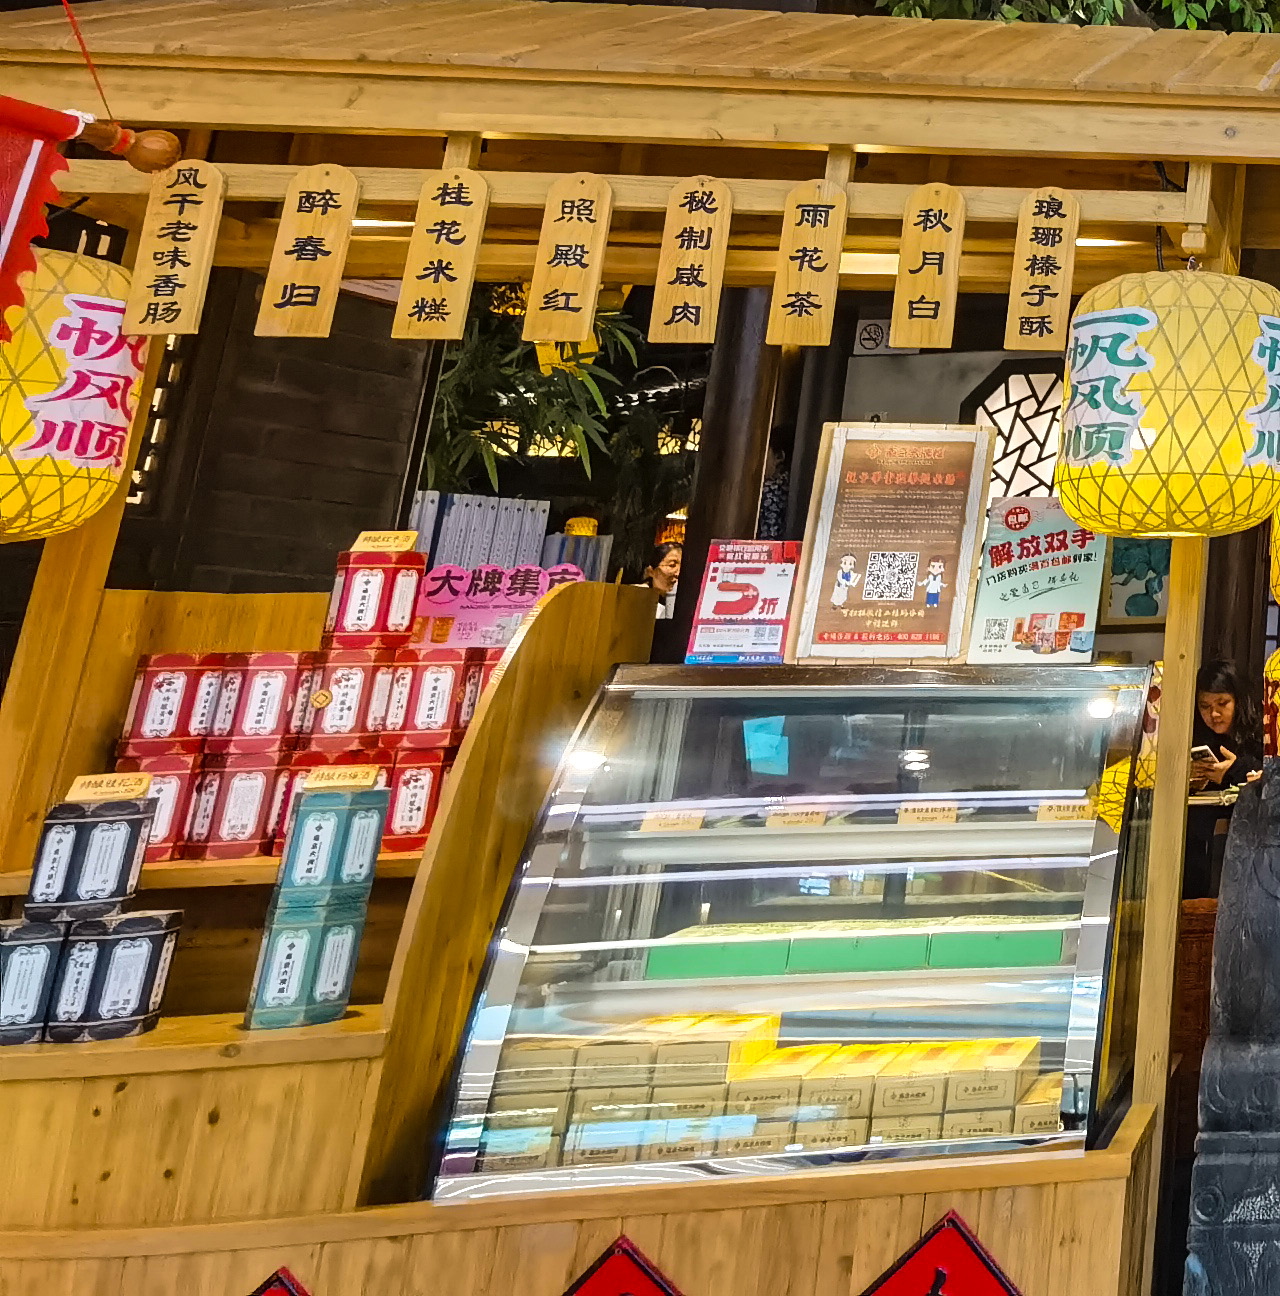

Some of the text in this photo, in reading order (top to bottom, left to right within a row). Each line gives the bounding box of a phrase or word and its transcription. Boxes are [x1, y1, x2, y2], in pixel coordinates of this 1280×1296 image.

[139, 167, 204, 326] 风干老味香肠
[273, 189, 342, 309] 醉春归
[409, 182, 473, 323] 桂花米糕
[539, 197, 597, 313] 照殿红
[664, 189, 718, 327] 秘制咸肉
[781, 202, 836, 318] 雨花茶
[907, 207, 952, 320] 秋月白
[1018, 196, 1068, 338] 琅琊榛子酥
[989, 528, 1096, 569] 解放双手
